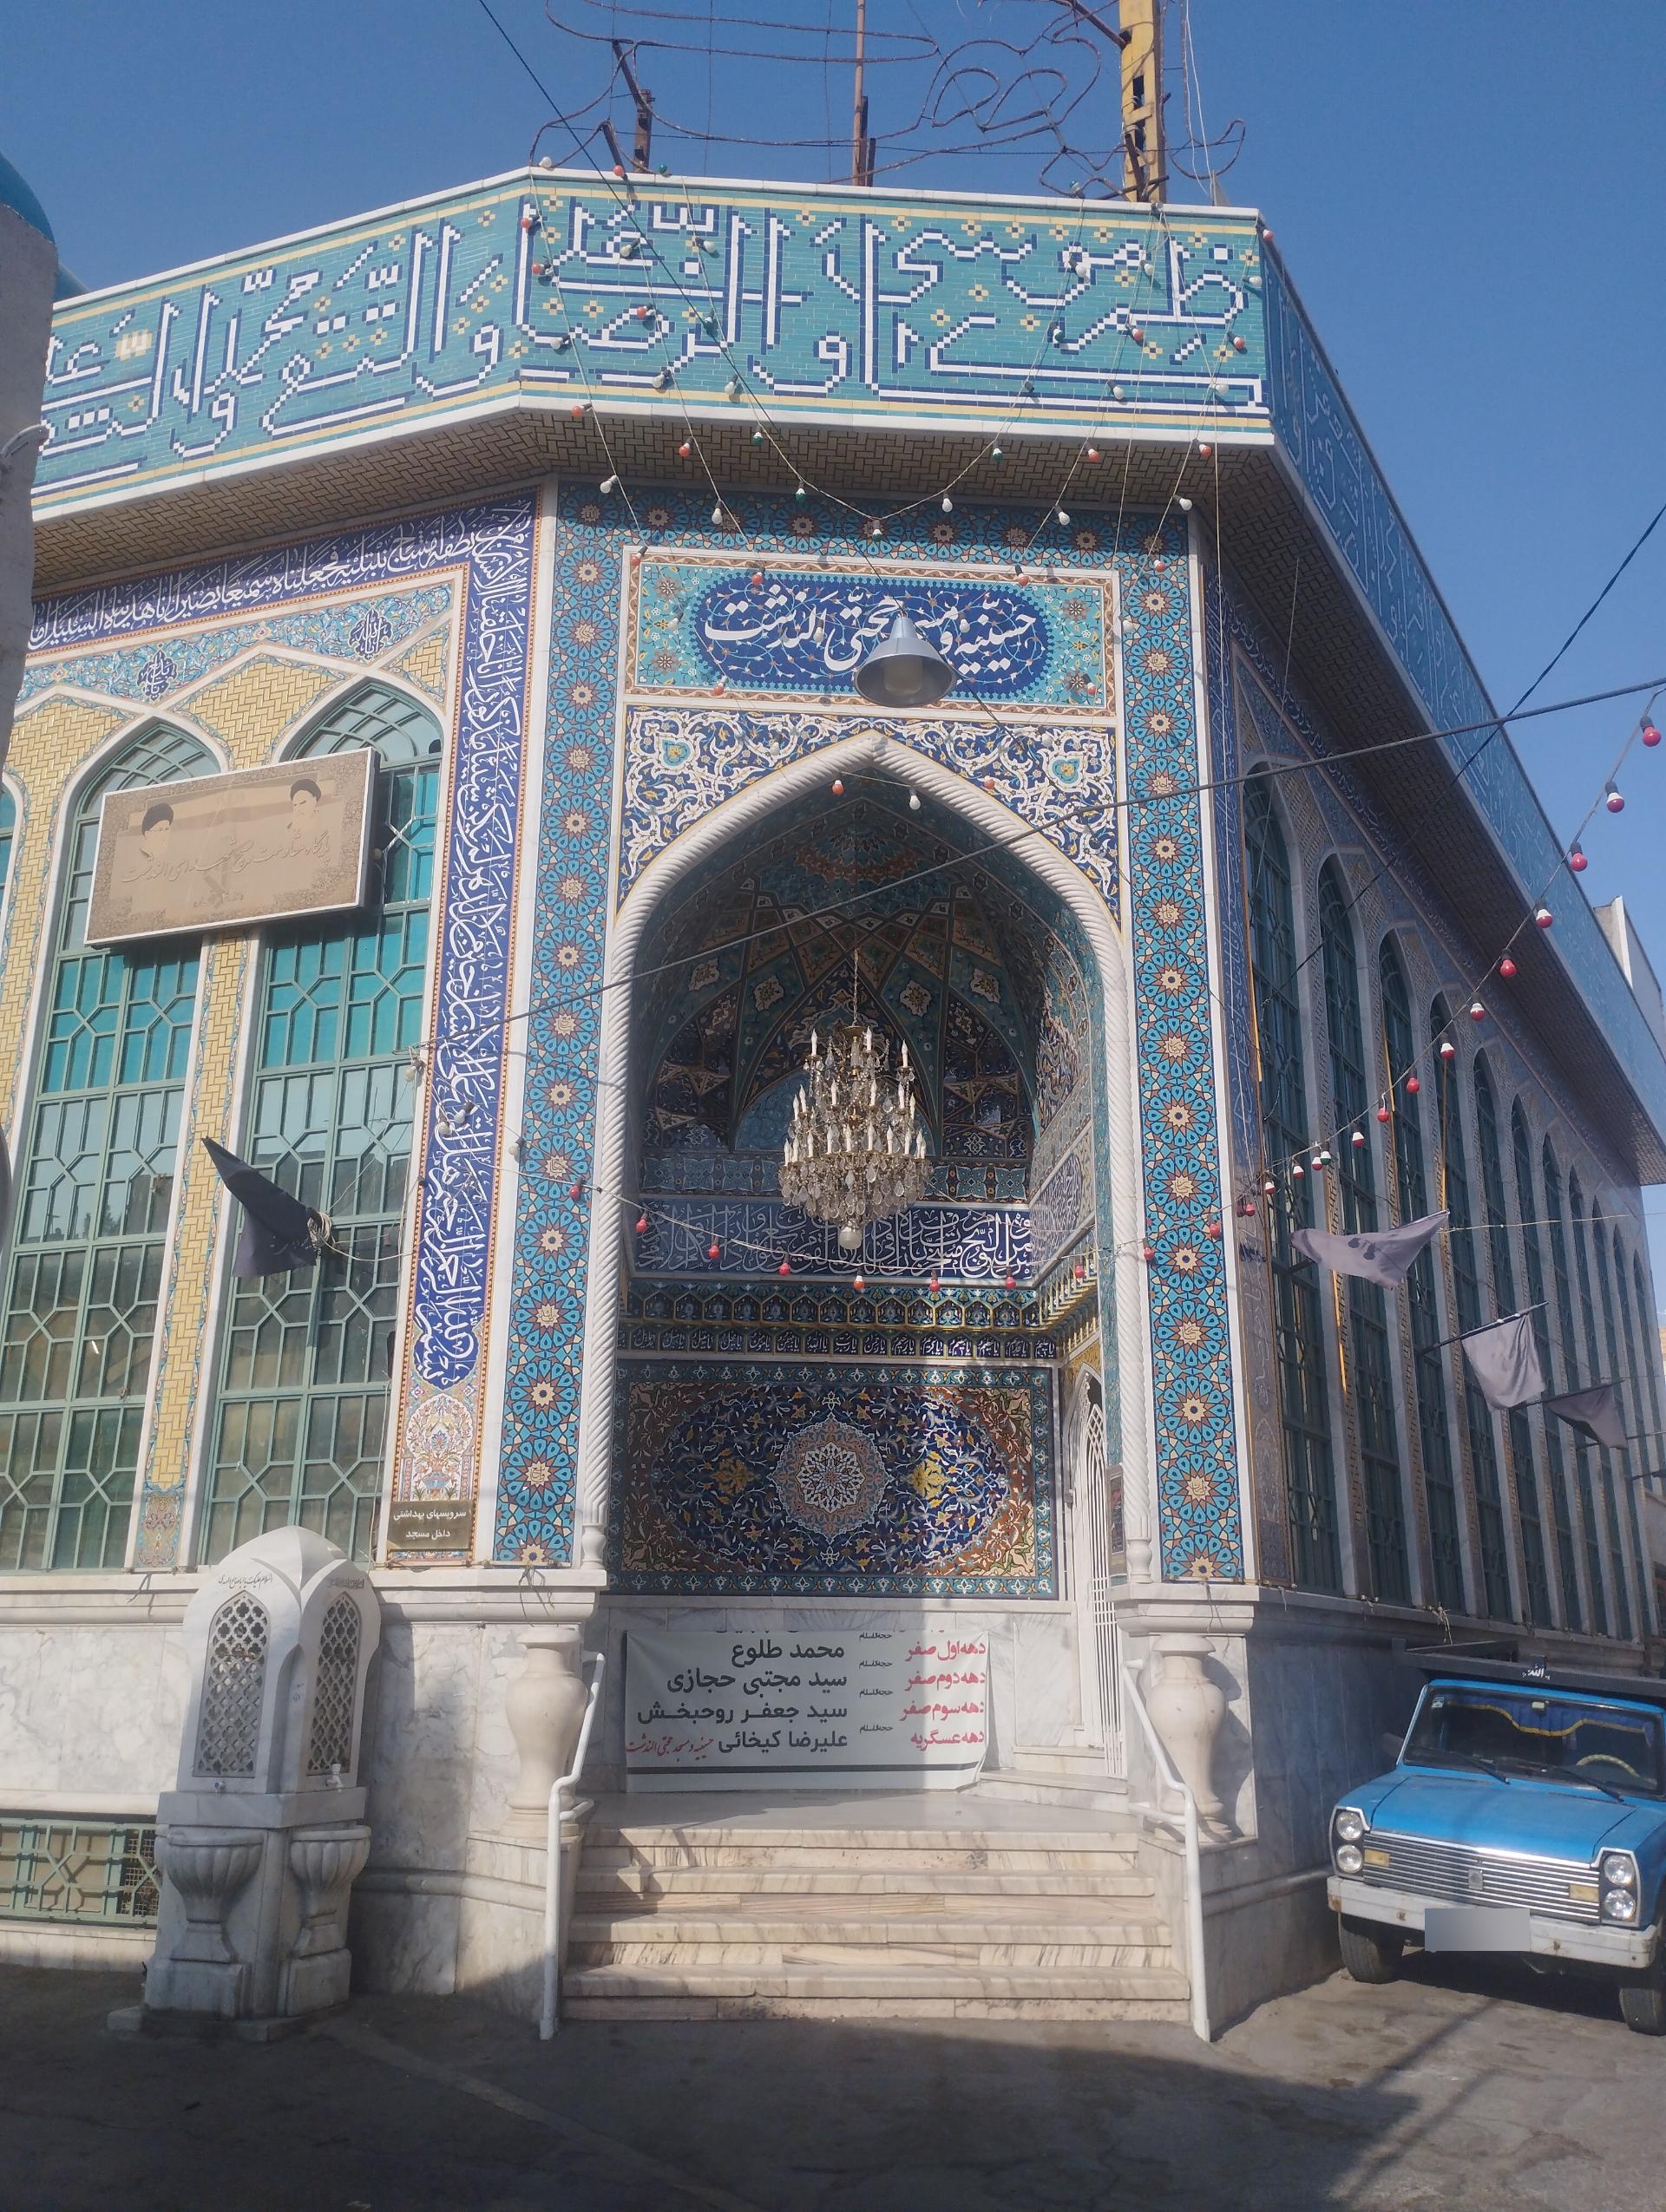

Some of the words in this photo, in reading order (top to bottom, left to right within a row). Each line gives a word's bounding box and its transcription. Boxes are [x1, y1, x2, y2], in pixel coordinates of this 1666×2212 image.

[393, 1508, 425, 1521] بهداشتی
[426, 1508, 467, 1521] سرویسهای
[405, 1530, 430, 1541] مسجد
[430, 1528, 451, 1541] داخل
[731, 1638, 784, 1668] طلوع
[790, 1643, 845, 1659] محمد
[904, 1640, 937, 1662] صفر
[937, 1639, 961, 1661] اول
[961, 1641, 987, 1655] دهه
[666, 1667, 737, 1693] حجازی
[743, 1670, 801, 1698] مجتبی
[808, 1672, 848, 1694] سید
[904, 1670, 937, 1692] صفر
[936, 1672, 961, 1691] دوم
[637, 1700, 734, 1725] روحبخش
[740, 1702, 800, 1724] جعفر
[806, 1705, 848, 1724] سید
[899, 1699, 932, 1722] صفر
[932, 1702, 961, 1721] سوم
[718, 1729, 782, 1754] کیخائی
[788, 1730, 848, 1753] علیرضا
[910, 1729, 961, 1751] عسگریه
